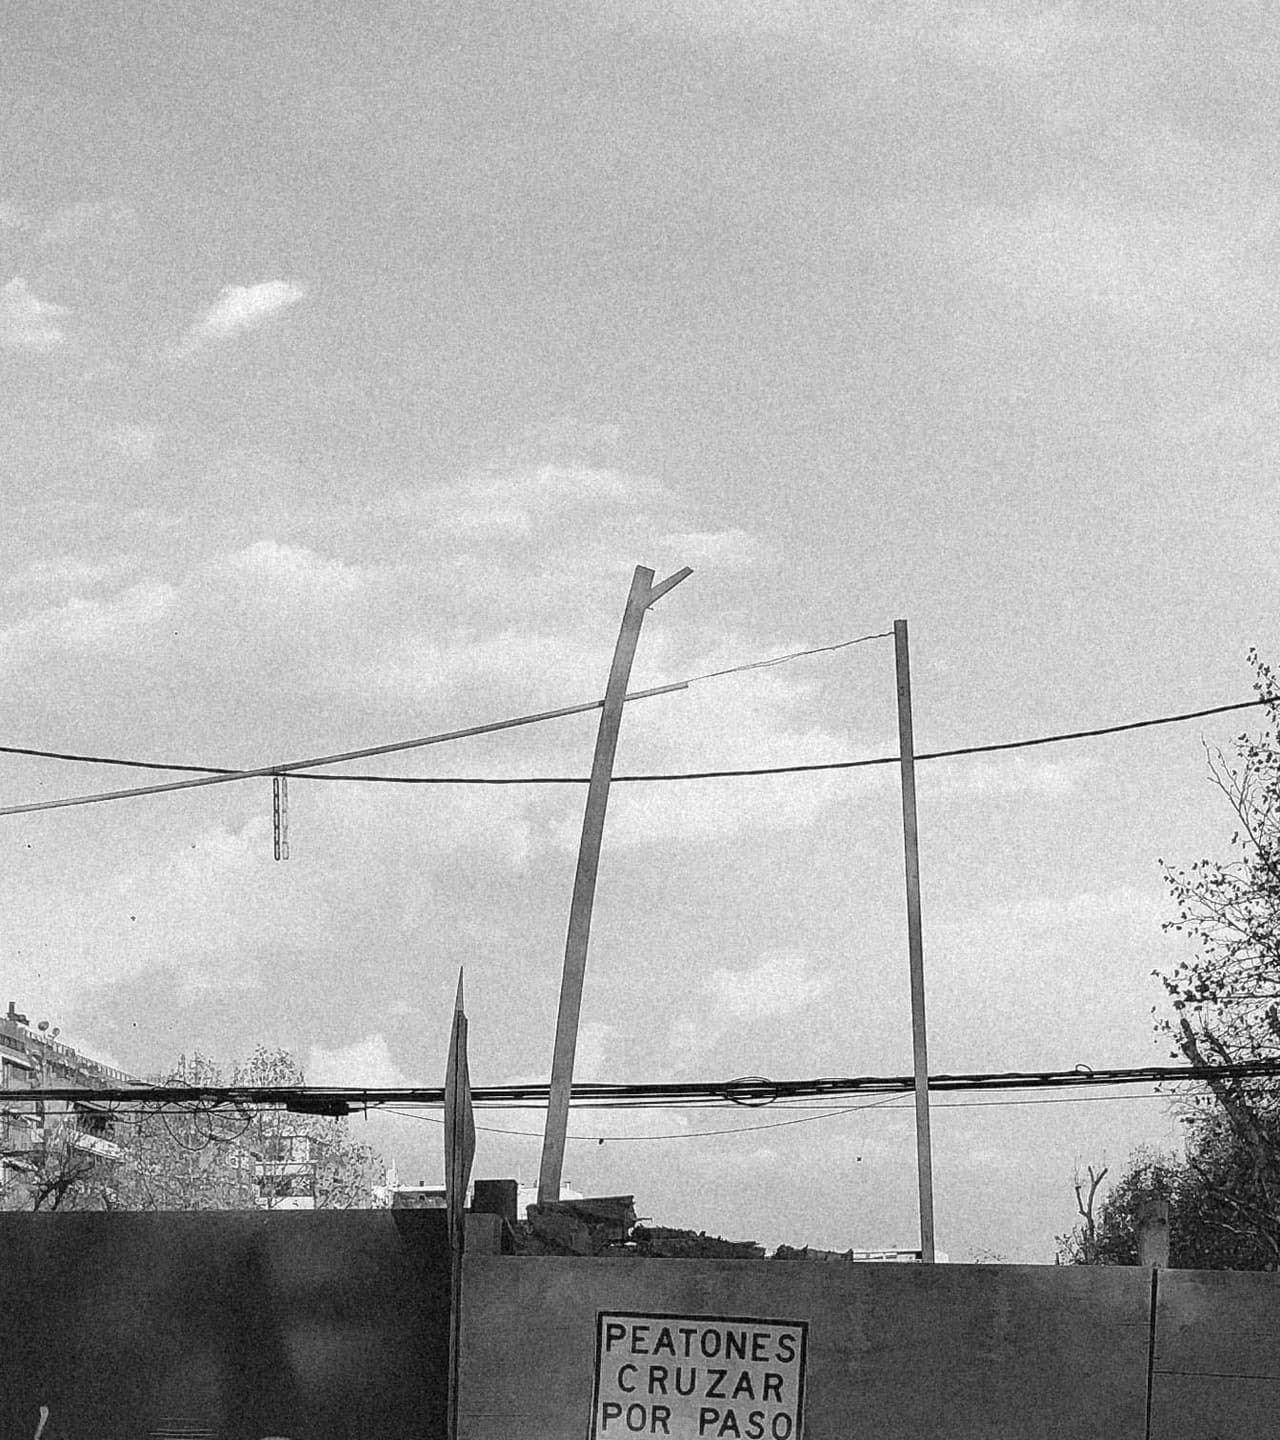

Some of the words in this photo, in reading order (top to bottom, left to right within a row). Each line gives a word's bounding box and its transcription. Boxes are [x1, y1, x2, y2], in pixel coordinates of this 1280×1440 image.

[605, 1323, 797, 1363] PEATONES
[617, 1363, 784, 1403] CRUZAR
[602, 1402, 671, 1434] POR
[699, 1407, 793, 1440] PASO
